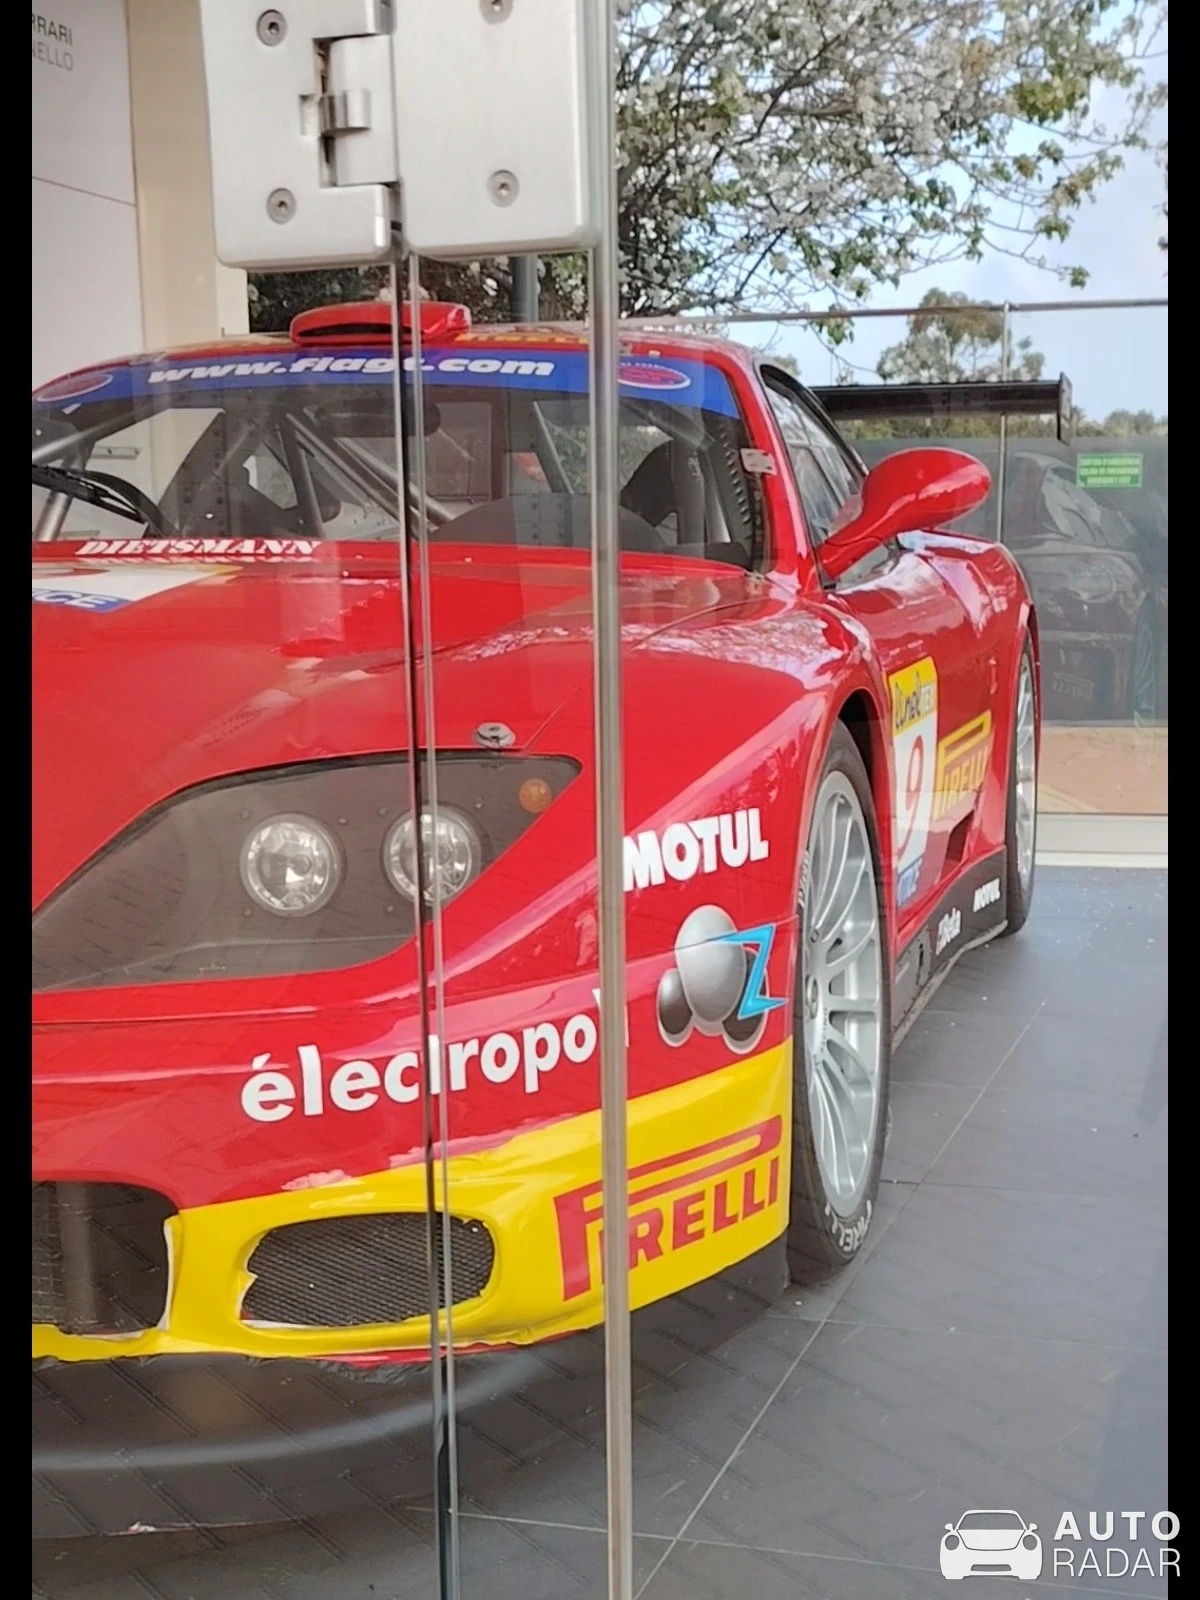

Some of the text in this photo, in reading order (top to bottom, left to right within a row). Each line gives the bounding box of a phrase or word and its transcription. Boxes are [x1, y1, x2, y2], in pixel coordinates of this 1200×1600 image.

[74, 539, 321, 555] DIETSMANN
[623, 807, 769, 892] MOTUL
[241, 988, 631, 1122] électropo
